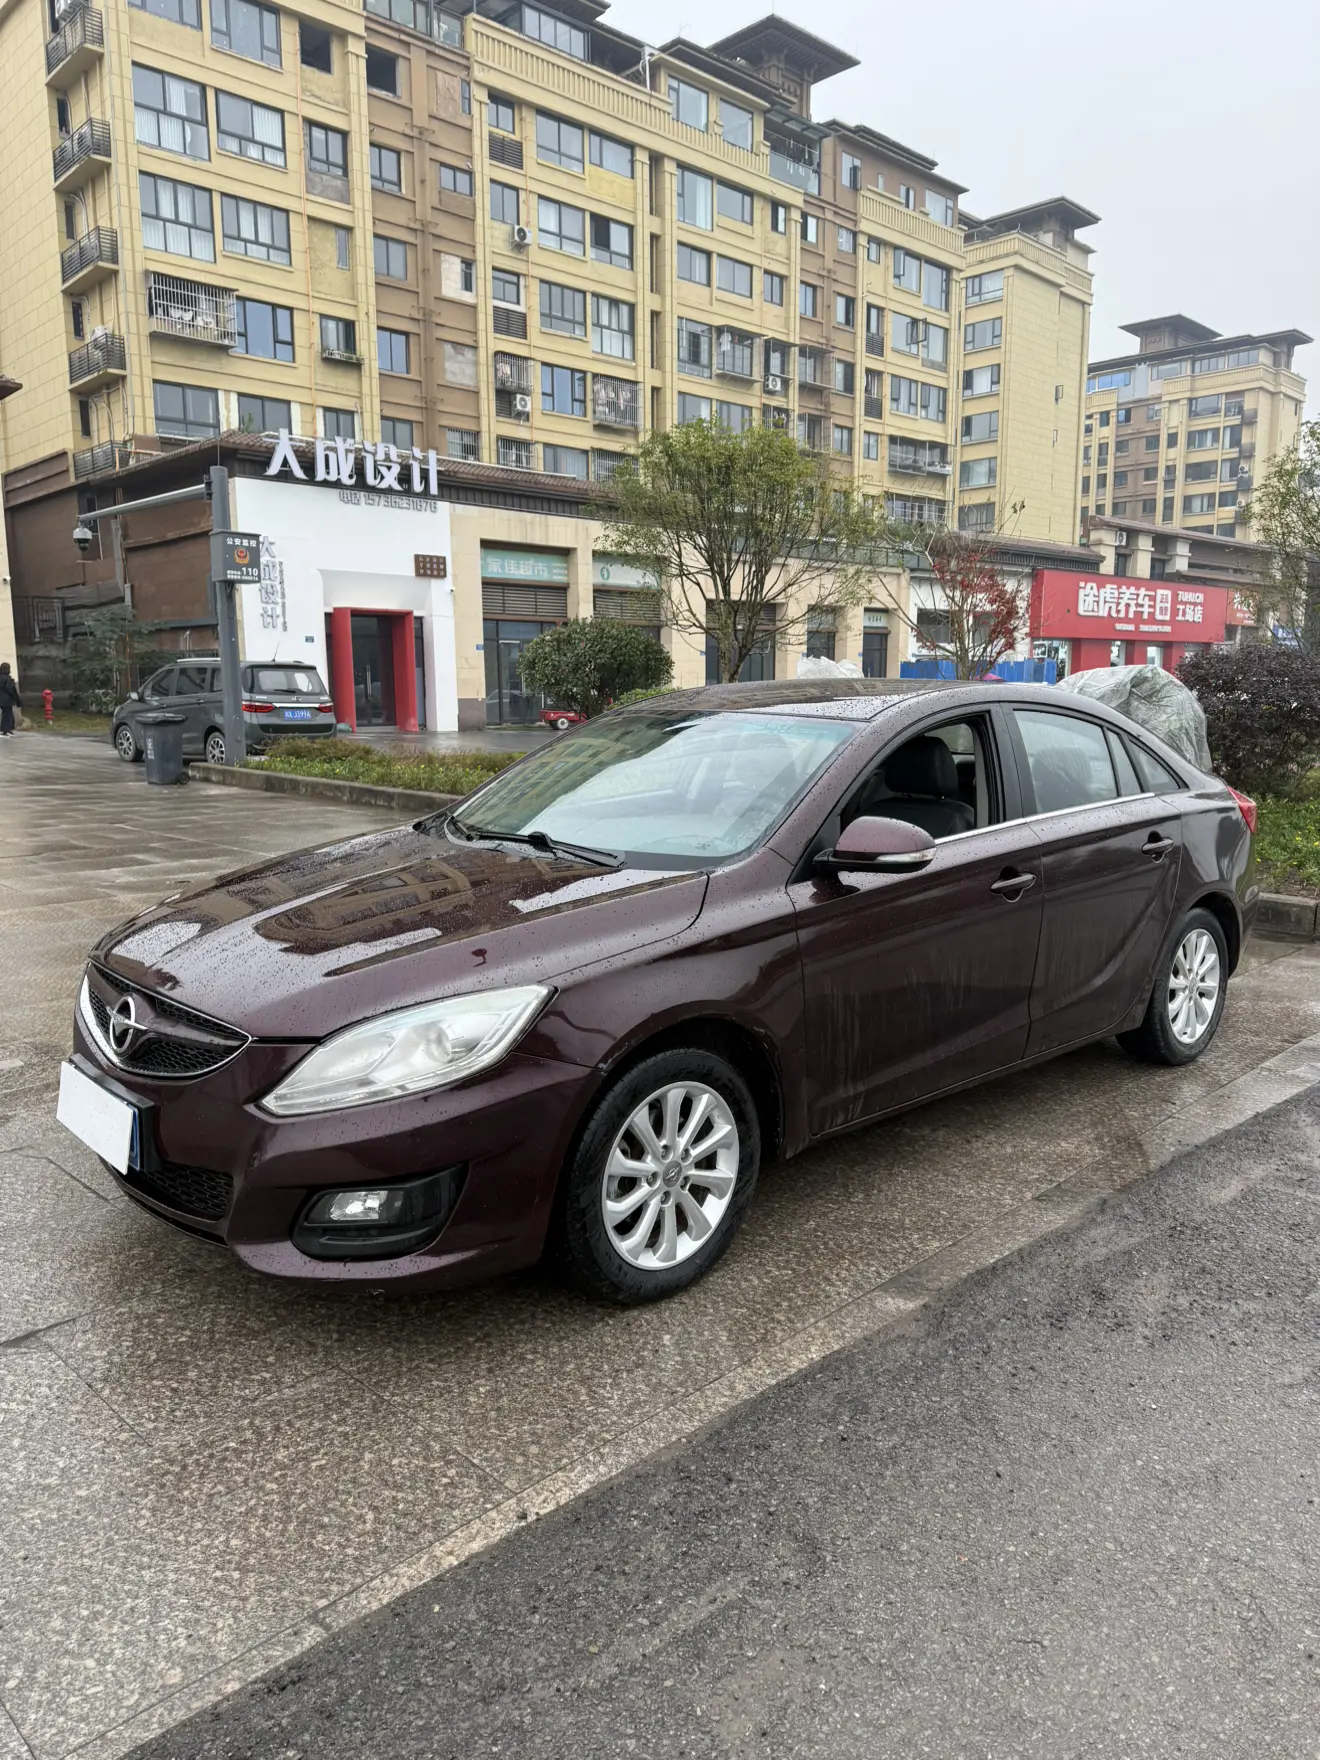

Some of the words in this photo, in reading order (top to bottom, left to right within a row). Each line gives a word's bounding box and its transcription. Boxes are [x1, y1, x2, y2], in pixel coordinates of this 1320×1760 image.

[263, 428, 445, 496] 大成设计
[226, 537, 257, 548] 公安监控
[241, 566, 259, 577] 110
[259, 535, 280, 629] 大成设计
[1077, 581, 1156, 620] 途虎养车
